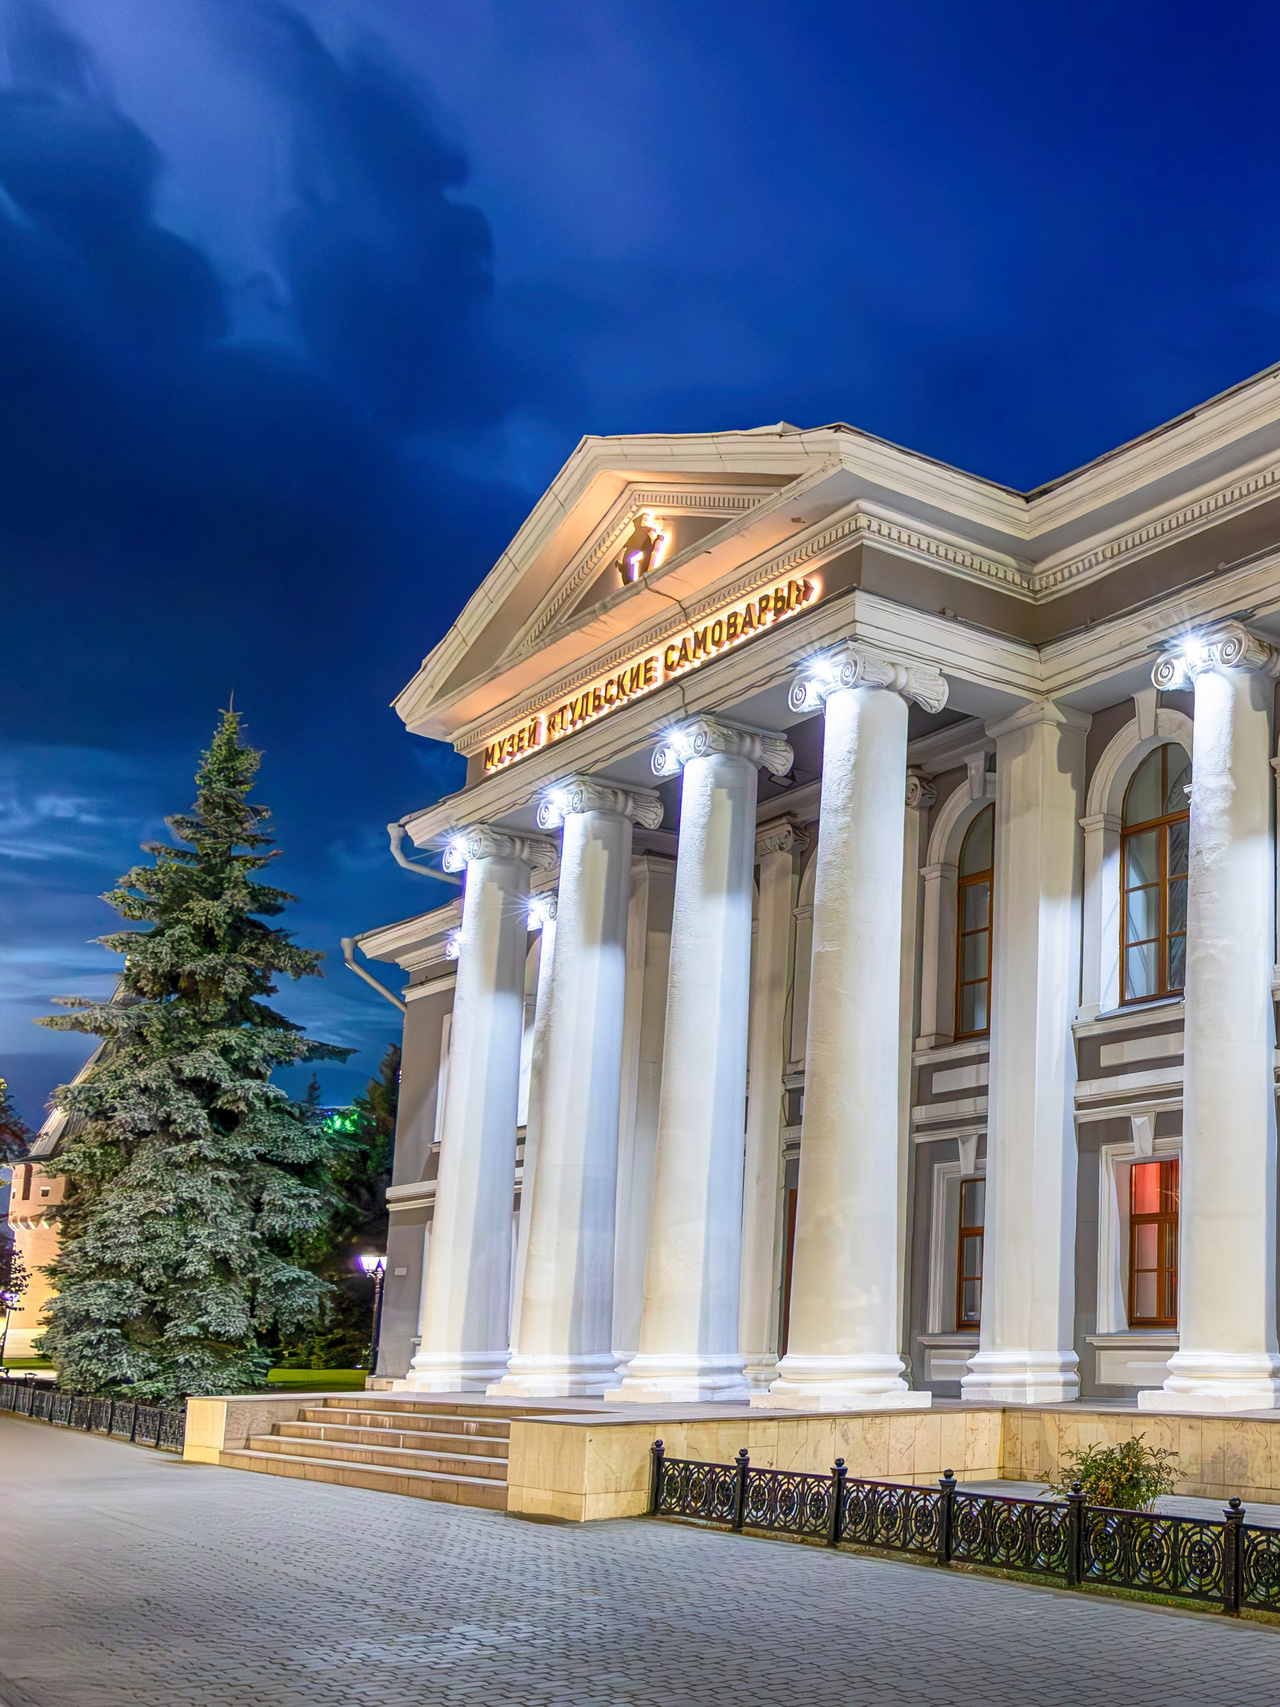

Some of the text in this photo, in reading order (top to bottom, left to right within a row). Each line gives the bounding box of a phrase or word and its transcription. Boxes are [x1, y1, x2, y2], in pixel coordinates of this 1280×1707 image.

[484, 579, 814, 770] МУЗЕЙ «ТУЛЬСКИЕ САМОВАРЫ»
